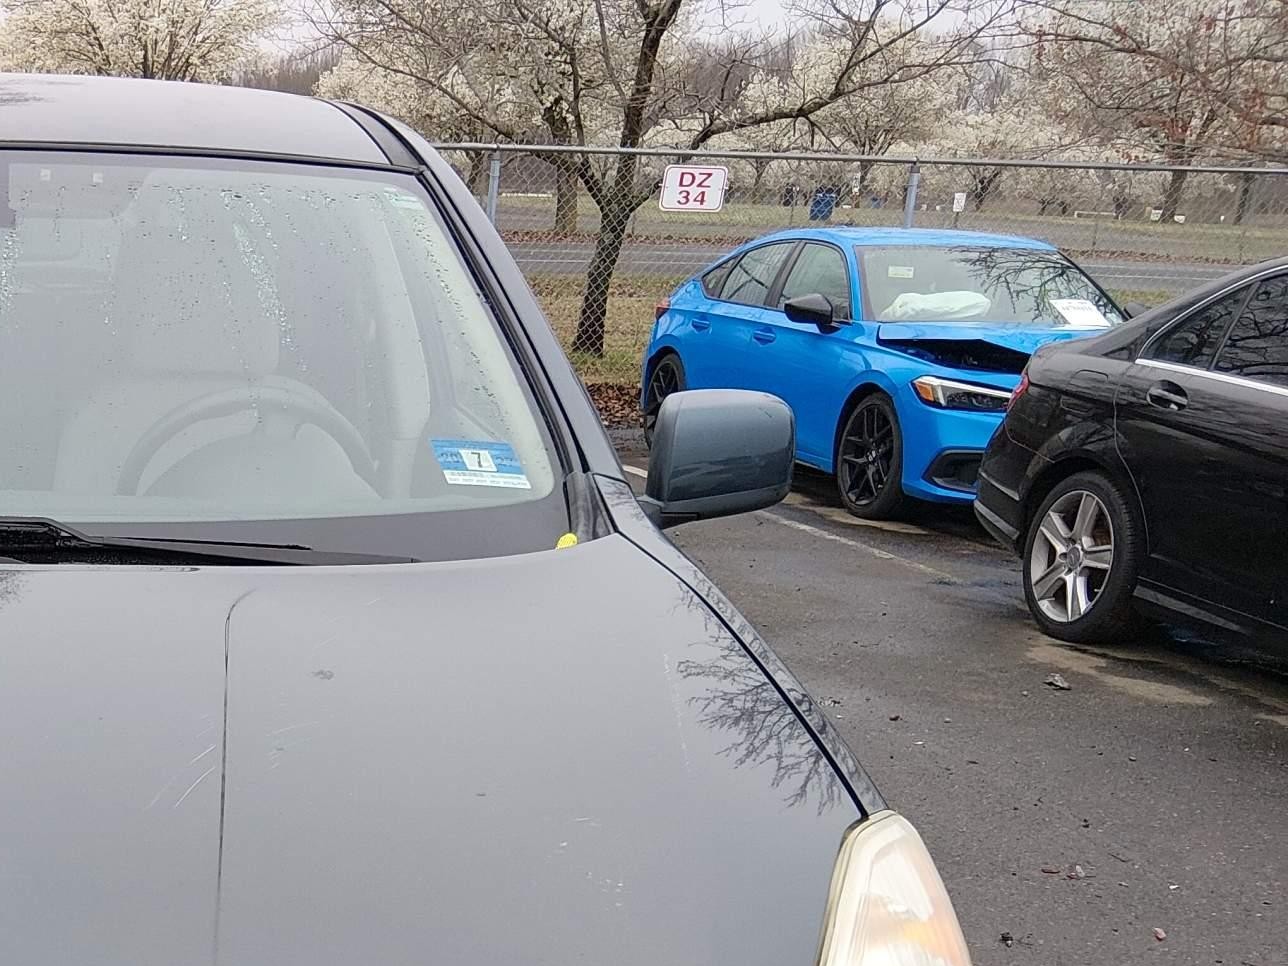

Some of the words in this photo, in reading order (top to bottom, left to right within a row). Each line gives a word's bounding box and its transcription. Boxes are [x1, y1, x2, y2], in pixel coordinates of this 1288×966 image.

[678, 171, 713, 188] DZ
[677, 190, 706, 206] 34
[470, 451, 483, 468] 7
